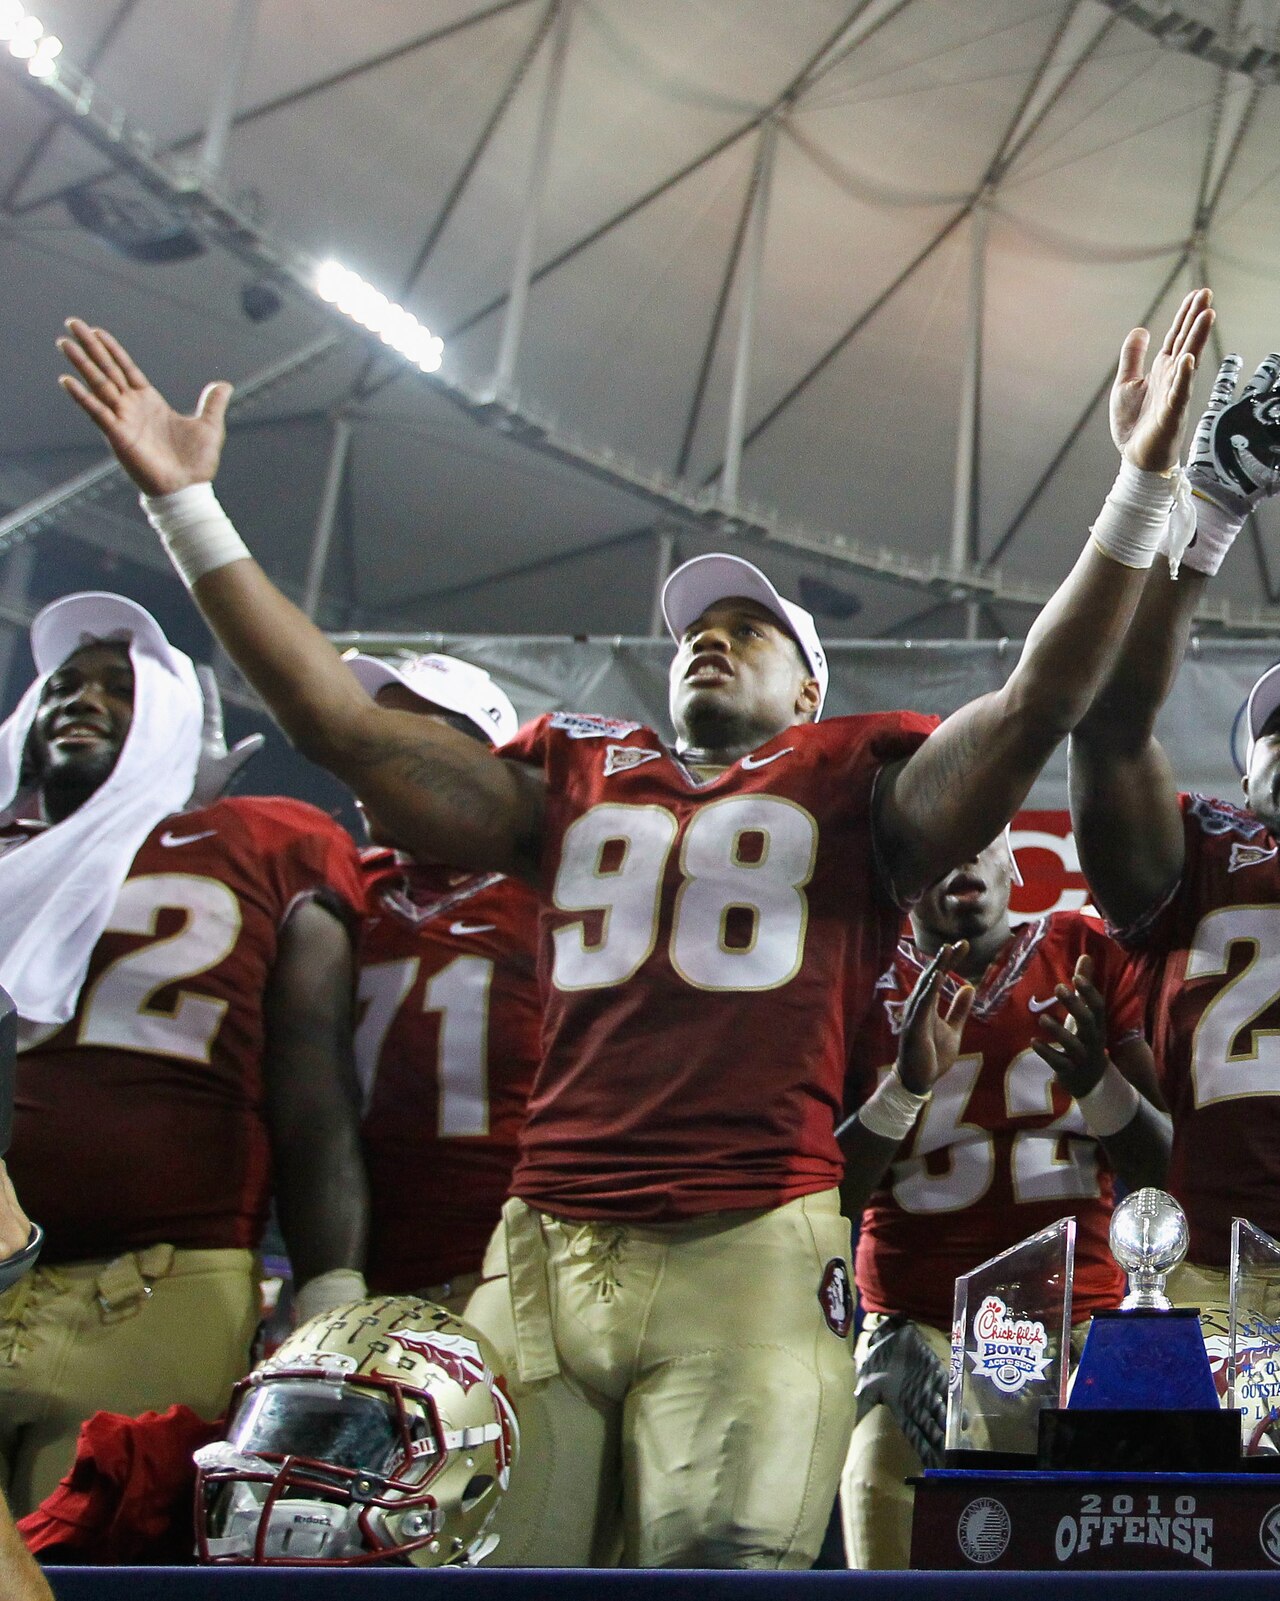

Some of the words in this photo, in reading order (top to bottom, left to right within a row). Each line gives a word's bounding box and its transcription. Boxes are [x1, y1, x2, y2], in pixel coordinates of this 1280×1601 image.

[552, 795, 820, 993] 98
[979, 1309, 1043, 1345] Chick-fil-A
[984, 1343, 1036, 1361] BOWL
[988, 1359, 1005, 1367] ACC
[1014, 1360, 1032, 1370] SEC
[1080, 1494, 1196, 1515] 2010
[1055, 1515, 1214, 1568] OFFENSE
